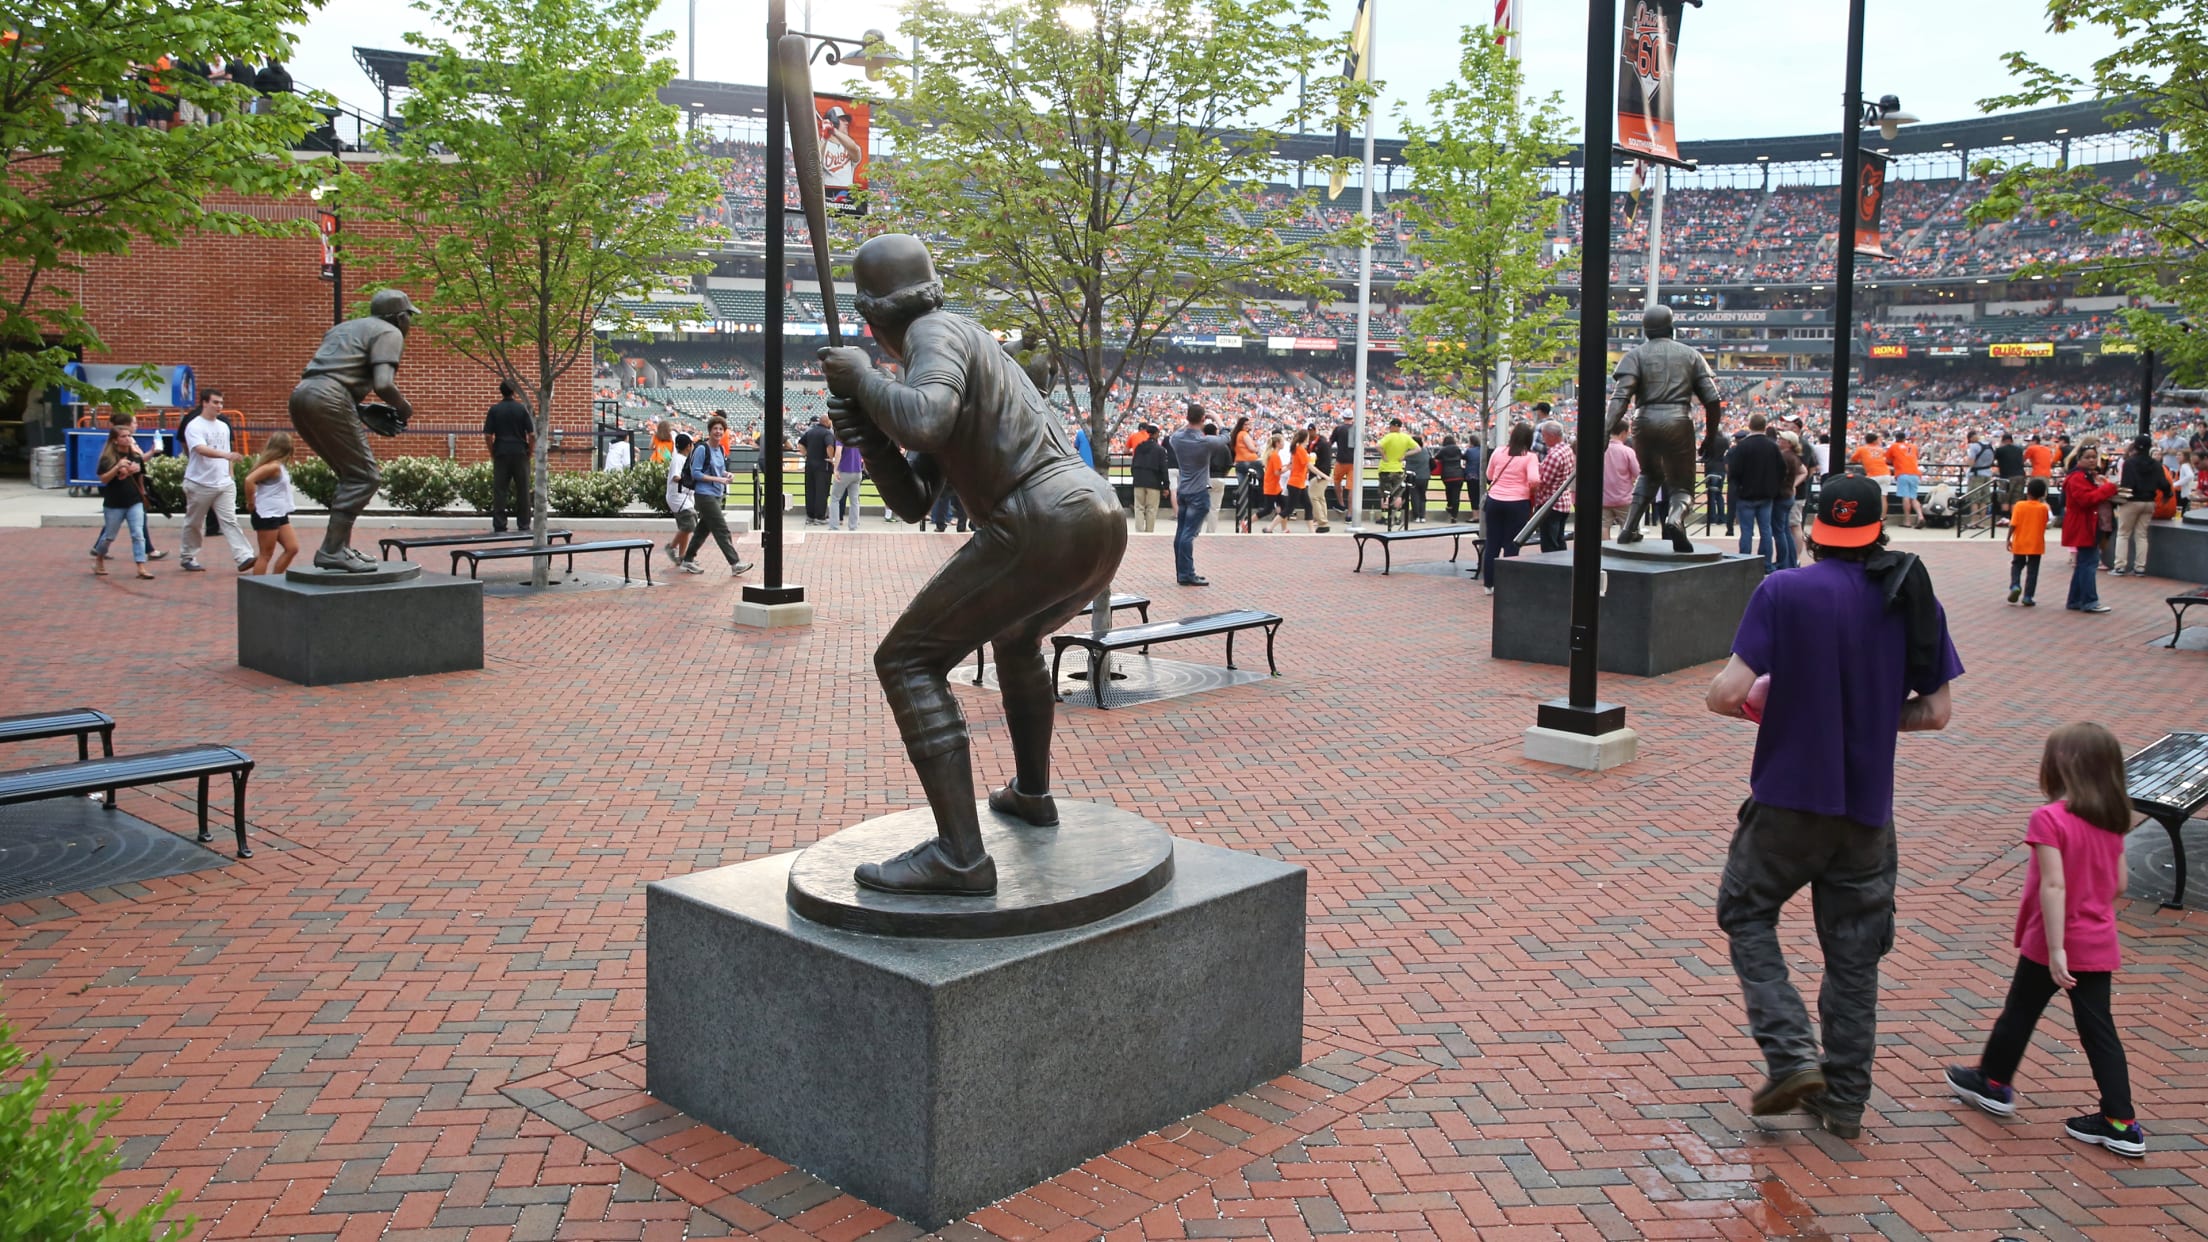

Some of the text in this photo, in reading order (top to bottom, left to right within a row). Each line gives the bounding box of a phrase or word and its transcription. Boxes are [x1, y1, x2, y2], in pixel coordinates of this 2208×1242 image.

[1696, 312, 1735, 322] CAMDEN
[1736, 312, 1767, 322] YARDS
[1873, 346, 1902, 355] ROMA
